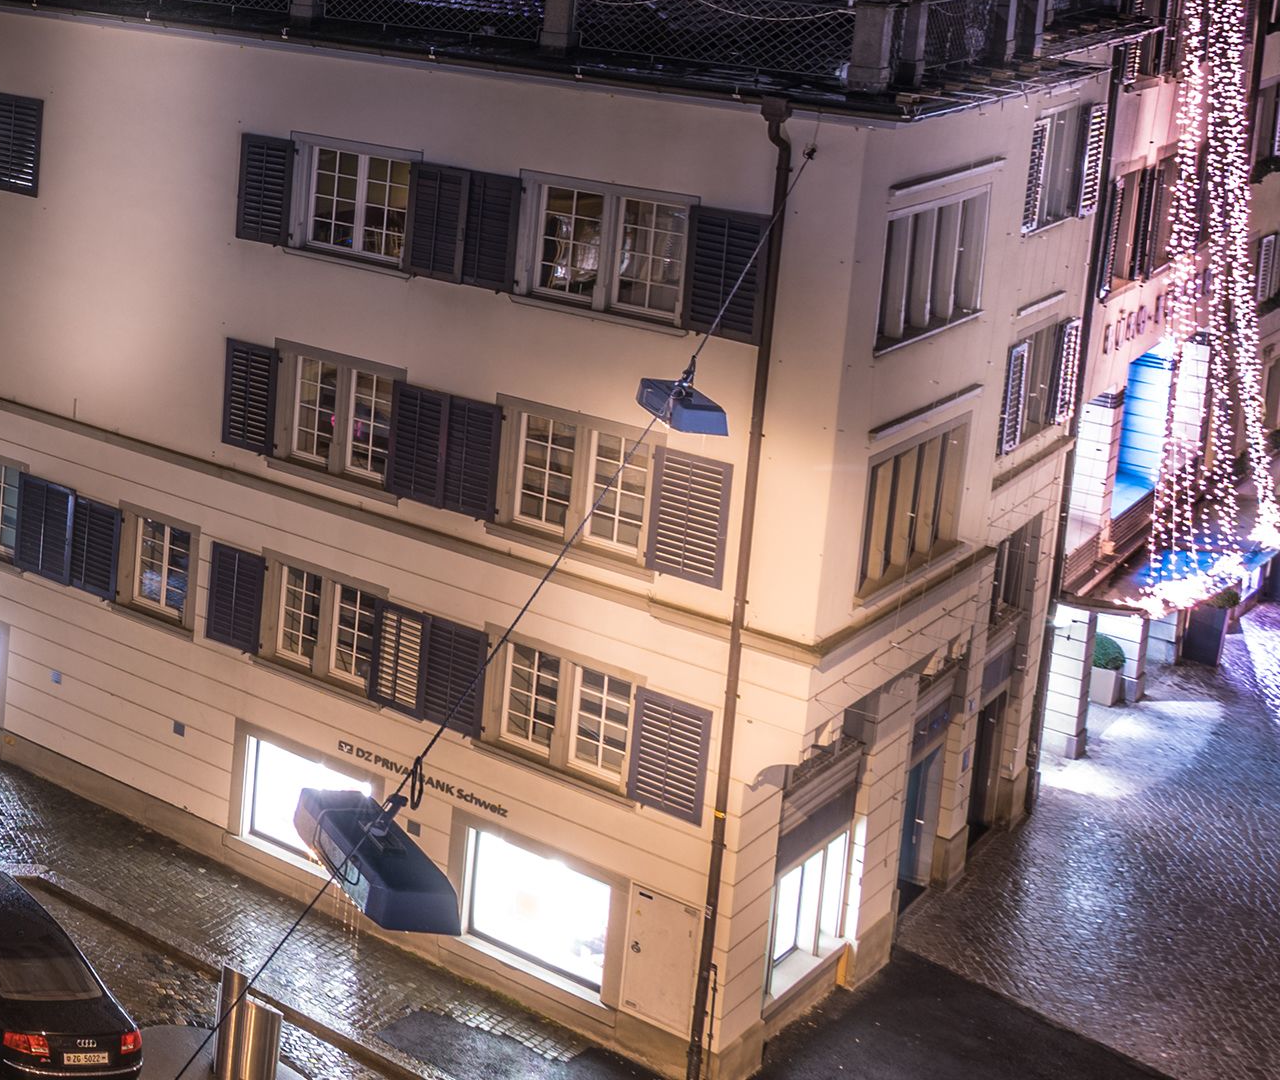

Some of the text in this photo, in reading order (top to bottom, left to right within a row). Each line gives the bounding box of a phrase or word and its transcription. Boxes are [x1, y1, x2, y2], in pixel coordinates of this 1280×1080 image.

[356, 747, 508, 818] DZ PRIVABANK Schweiz
[72, 1054, 81, 1063] ZG
